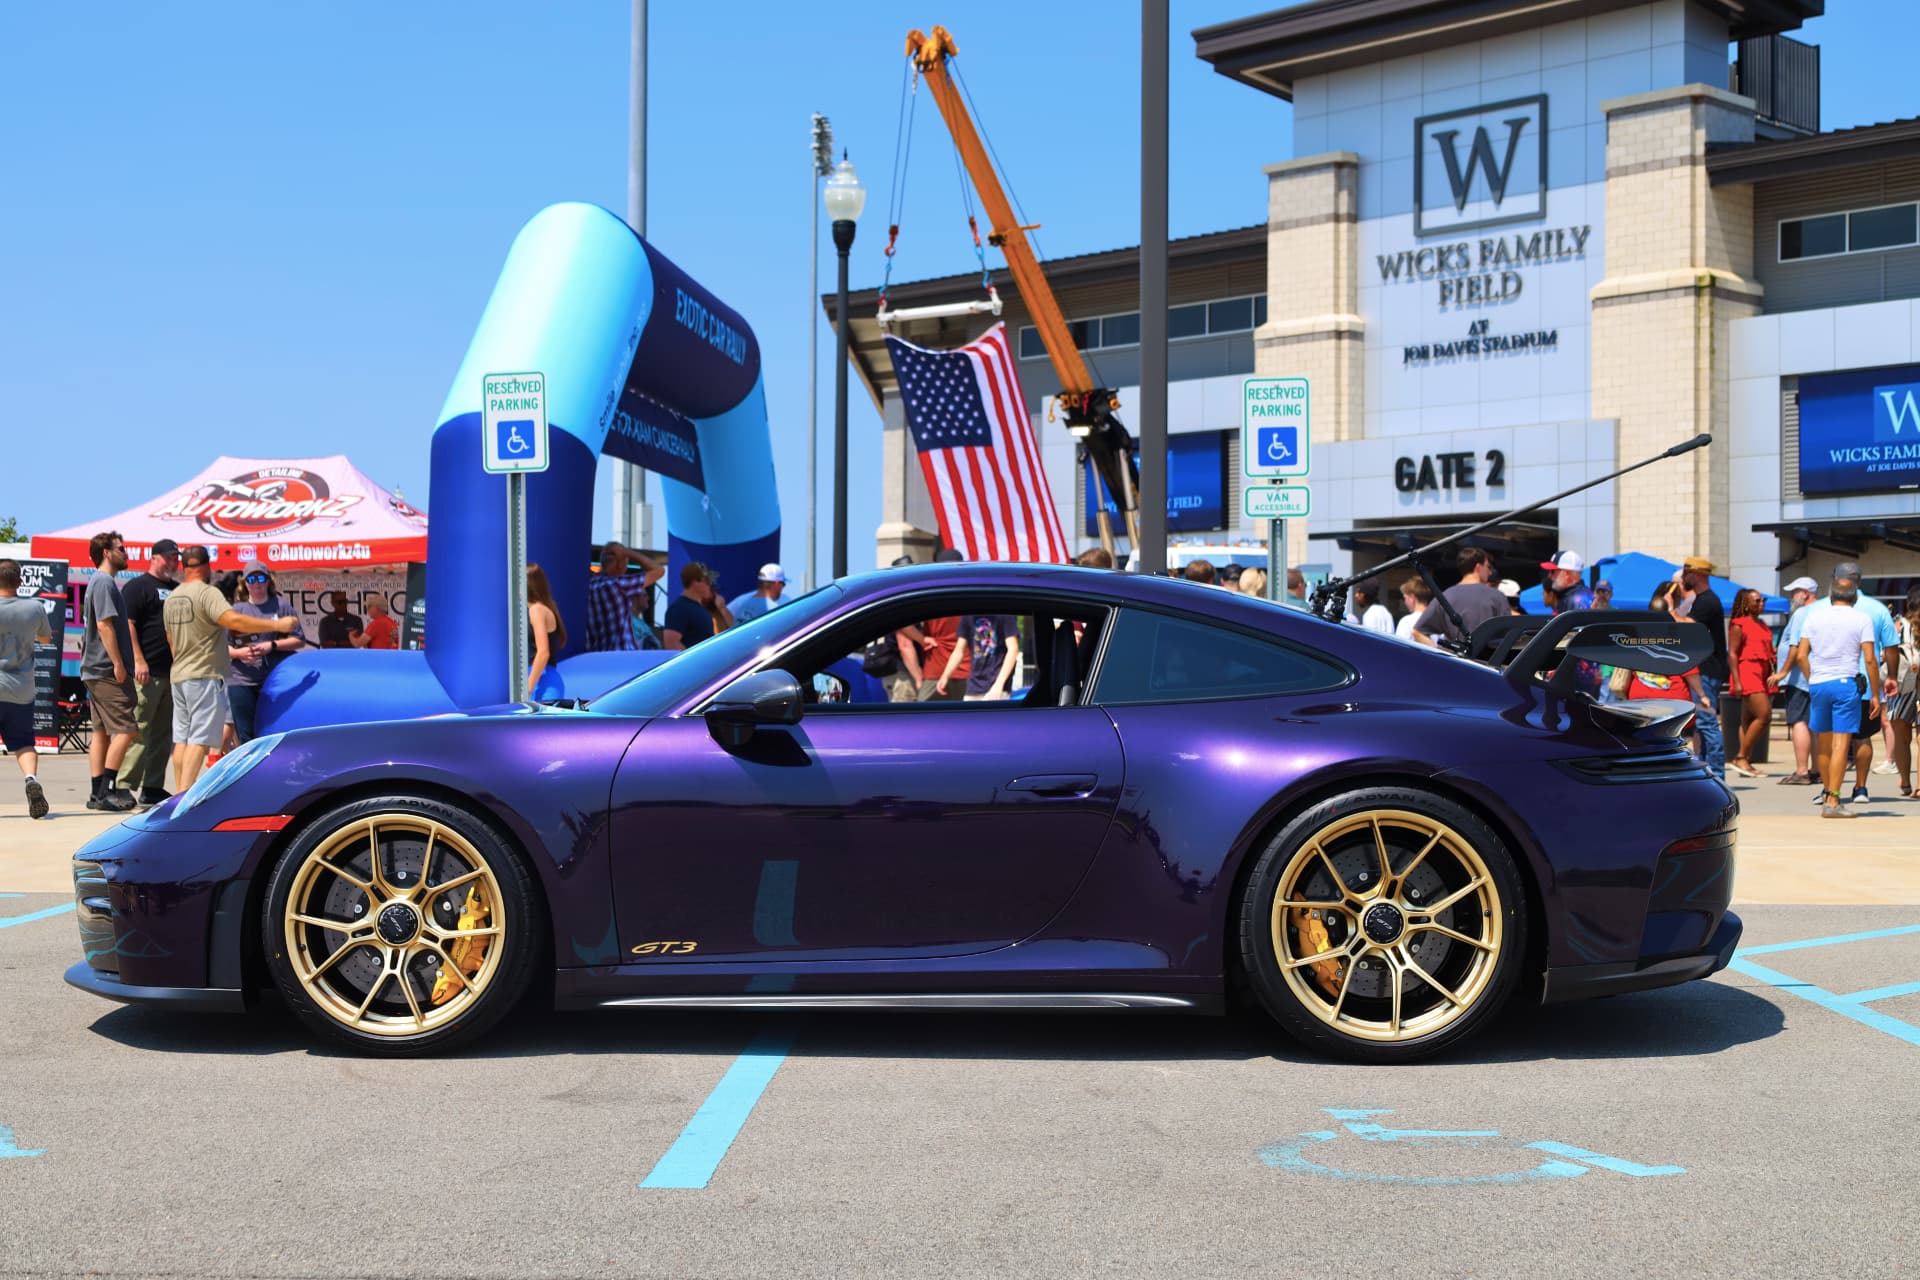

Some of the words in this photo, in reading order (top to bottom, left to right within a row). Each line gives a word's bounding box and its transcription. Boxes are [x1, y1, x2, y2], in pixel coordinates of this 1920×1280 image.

[1431, 116, 1531, 212] W
[1376, 242, 1471, 281] WICKS
[1478, 225, 1591, 267] FAMILY
[1438, 271, 1523, 306] FIELD
[676, 287, 709, 340] EXOTIC
[709, 313, 727, 353] CAR
[1468, 319, 1490, 336] AT
[1403, 344, 1430, 364] JOE
[1432, 337, 1480, 357] DAVIS
[1482, 330, 1558, 353] STADIUM
[487, 380, 542, 395] RESERVED
[1248, 386, 1305, 400] RESERVED
[490, 397, 539, 411] PARKING
[1251, 403, 1303, 417] PARKING
[1830, 447, 1881, 463] WICKS
[1395, 451, 1475, 492] GATE
[1485, 449, 1505, 486] 2
[1173, 496, 1202, 509] FIELD
[1266, 492, 1290, 502] VAN
[152, 495, 364, 519] AUTOWORKZ
[1254, 504, 1301, 512] ACCESSIBLE
[267, 543, 371, 562] @Autoworkz4u
[1353, 793, 1415, 803] ADVAN
[398, 798, 453, 817] ADVAN
[631, 941, 698, 954] GT3
